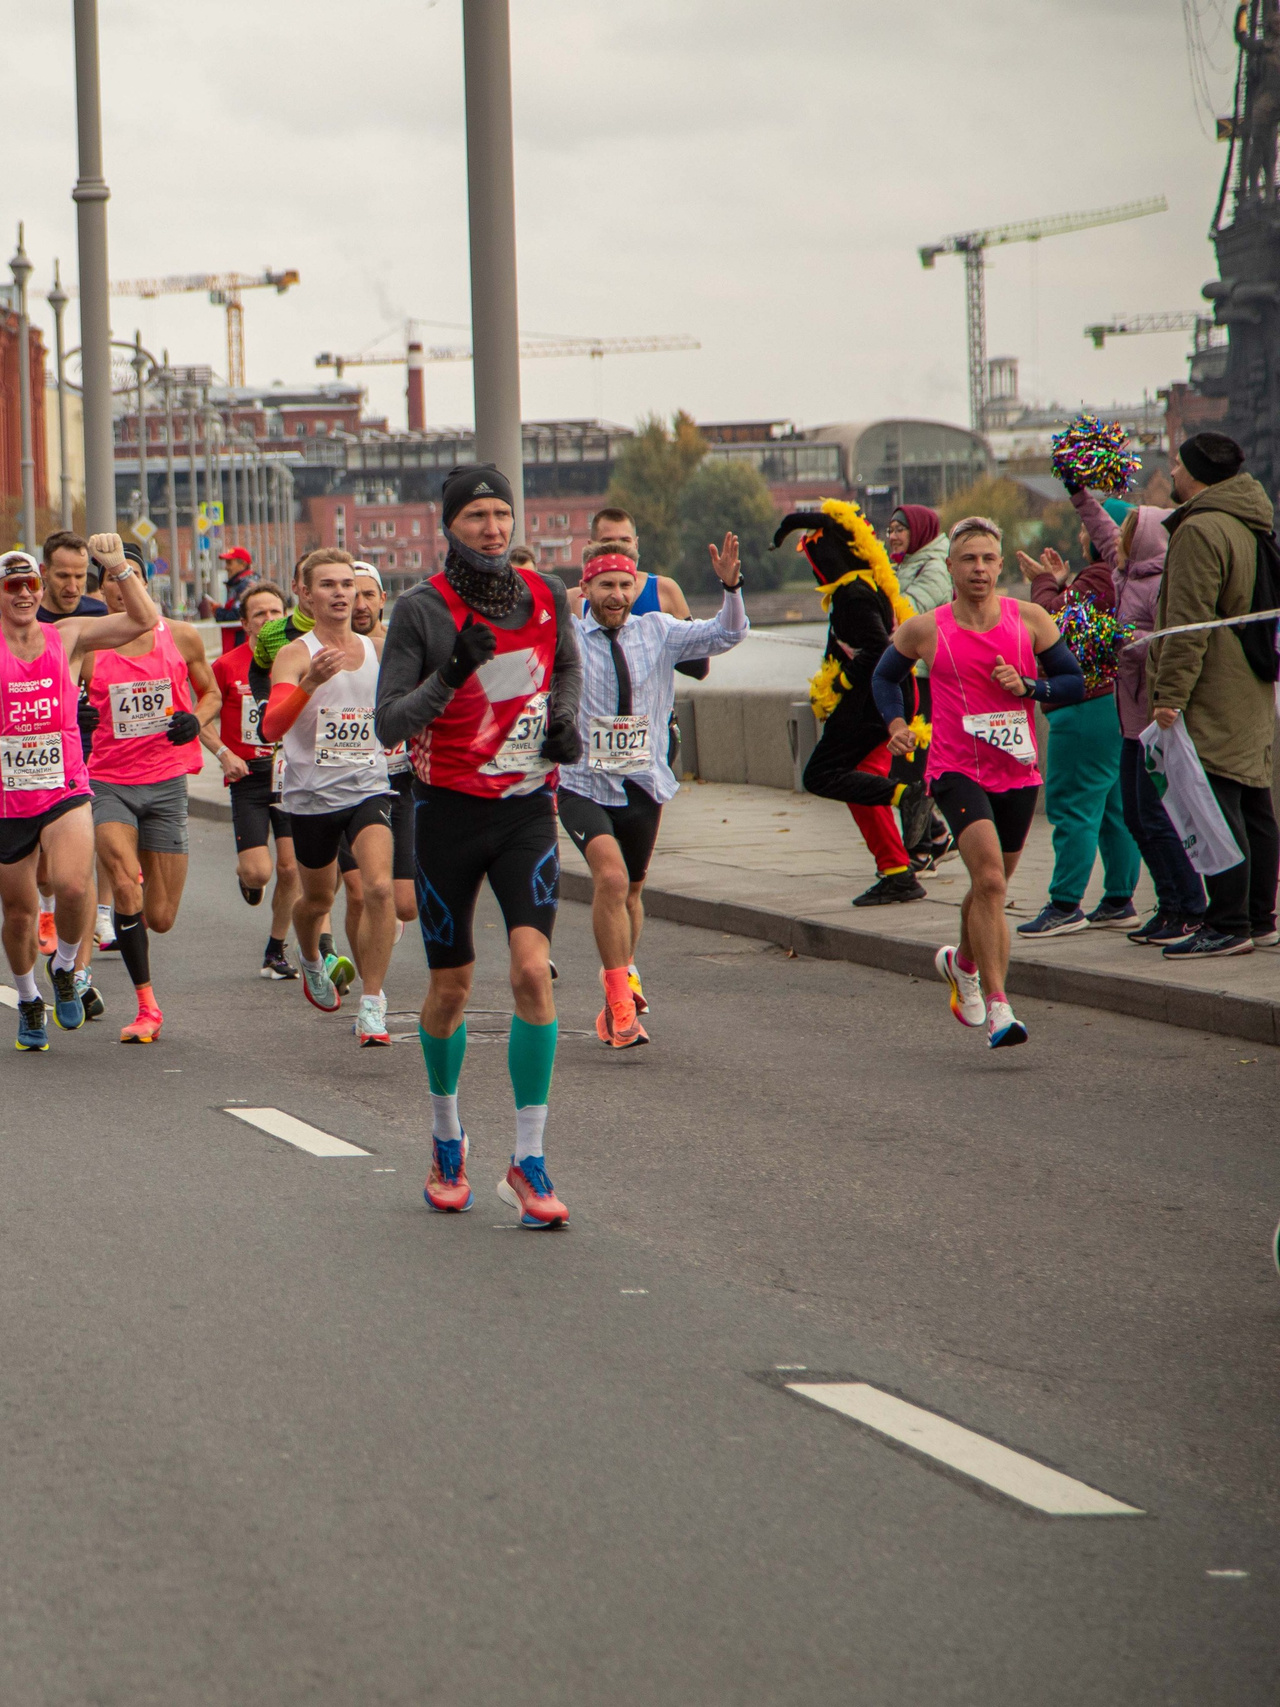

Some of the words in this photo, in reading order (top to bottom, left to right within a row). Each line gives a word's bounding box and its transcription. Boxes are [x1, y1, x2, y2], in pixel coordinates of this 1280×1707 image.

[473, 488, 494, 496] adidas
[8, 680, 40, 688] МАРАФОН
[10, 698, 51, 722] 2:49
[119, 694, 164, 713] 4189
[131, 712, 155, 720] АНДРЕЙ
[325, 722, 370, 740] 3696
[593, 729, 647, 749] 11027
[3, 747, 60, 767] 16468
